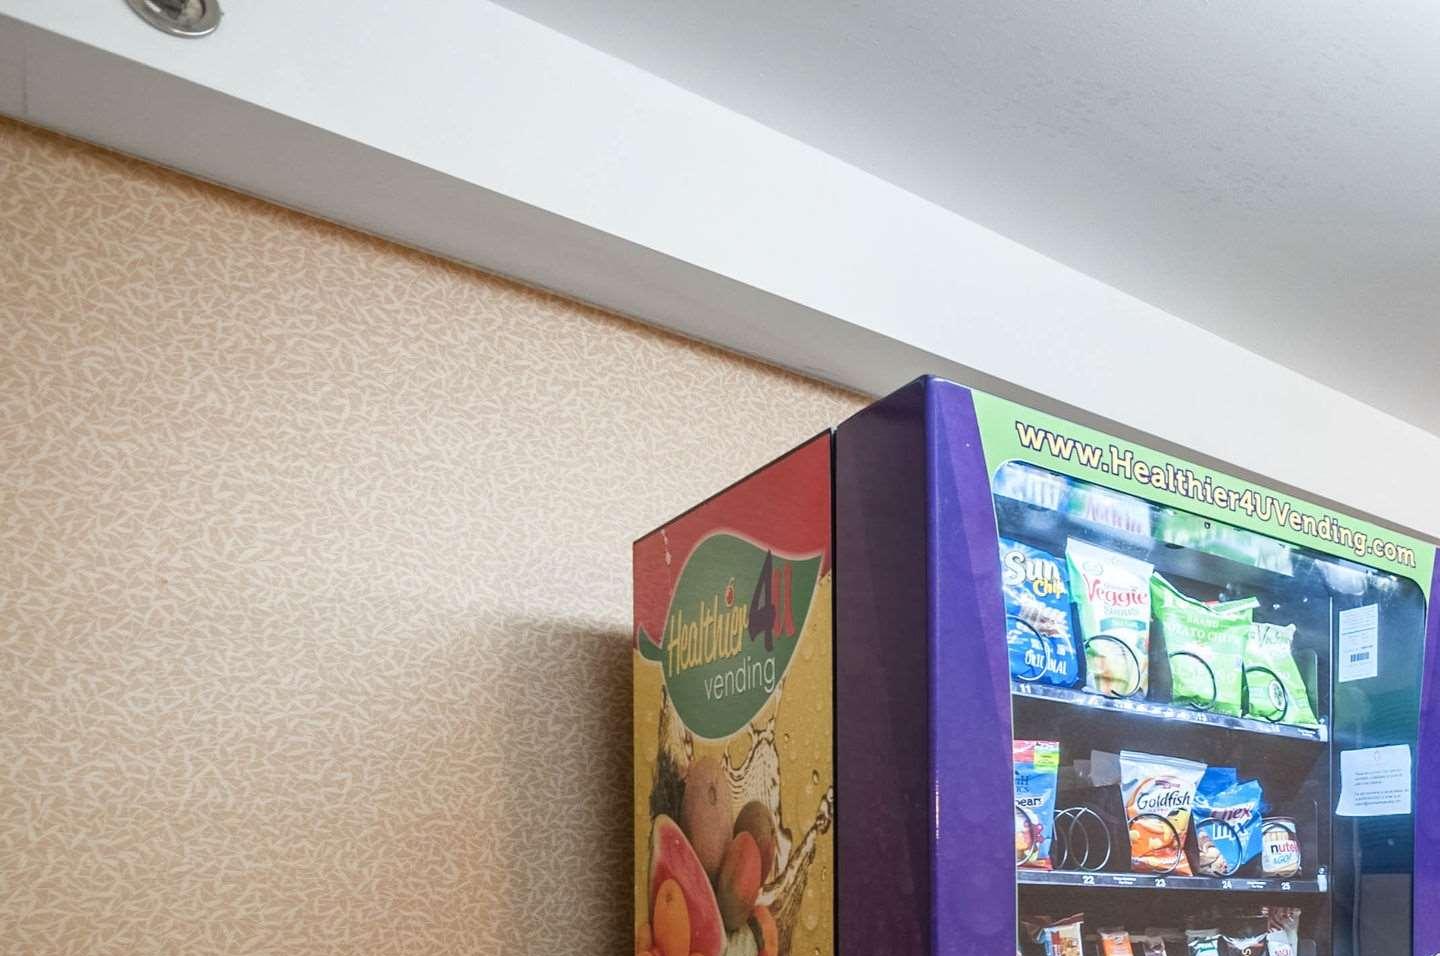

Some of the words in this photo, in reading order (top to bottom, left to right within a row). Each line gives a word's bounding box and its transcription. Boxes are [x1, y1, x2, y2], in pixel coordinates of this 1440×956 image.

[1014, 420, 1417, 569] www.Healthier4UVending.com
[1084, 573, 1148, 607] Veggie
[704, 656, 777, 702] vending
[1137, 791, 1191, 810] Goldfish
[1221, 879, 1233, 890] 24
[1280, 881, 1292, 891] 25
